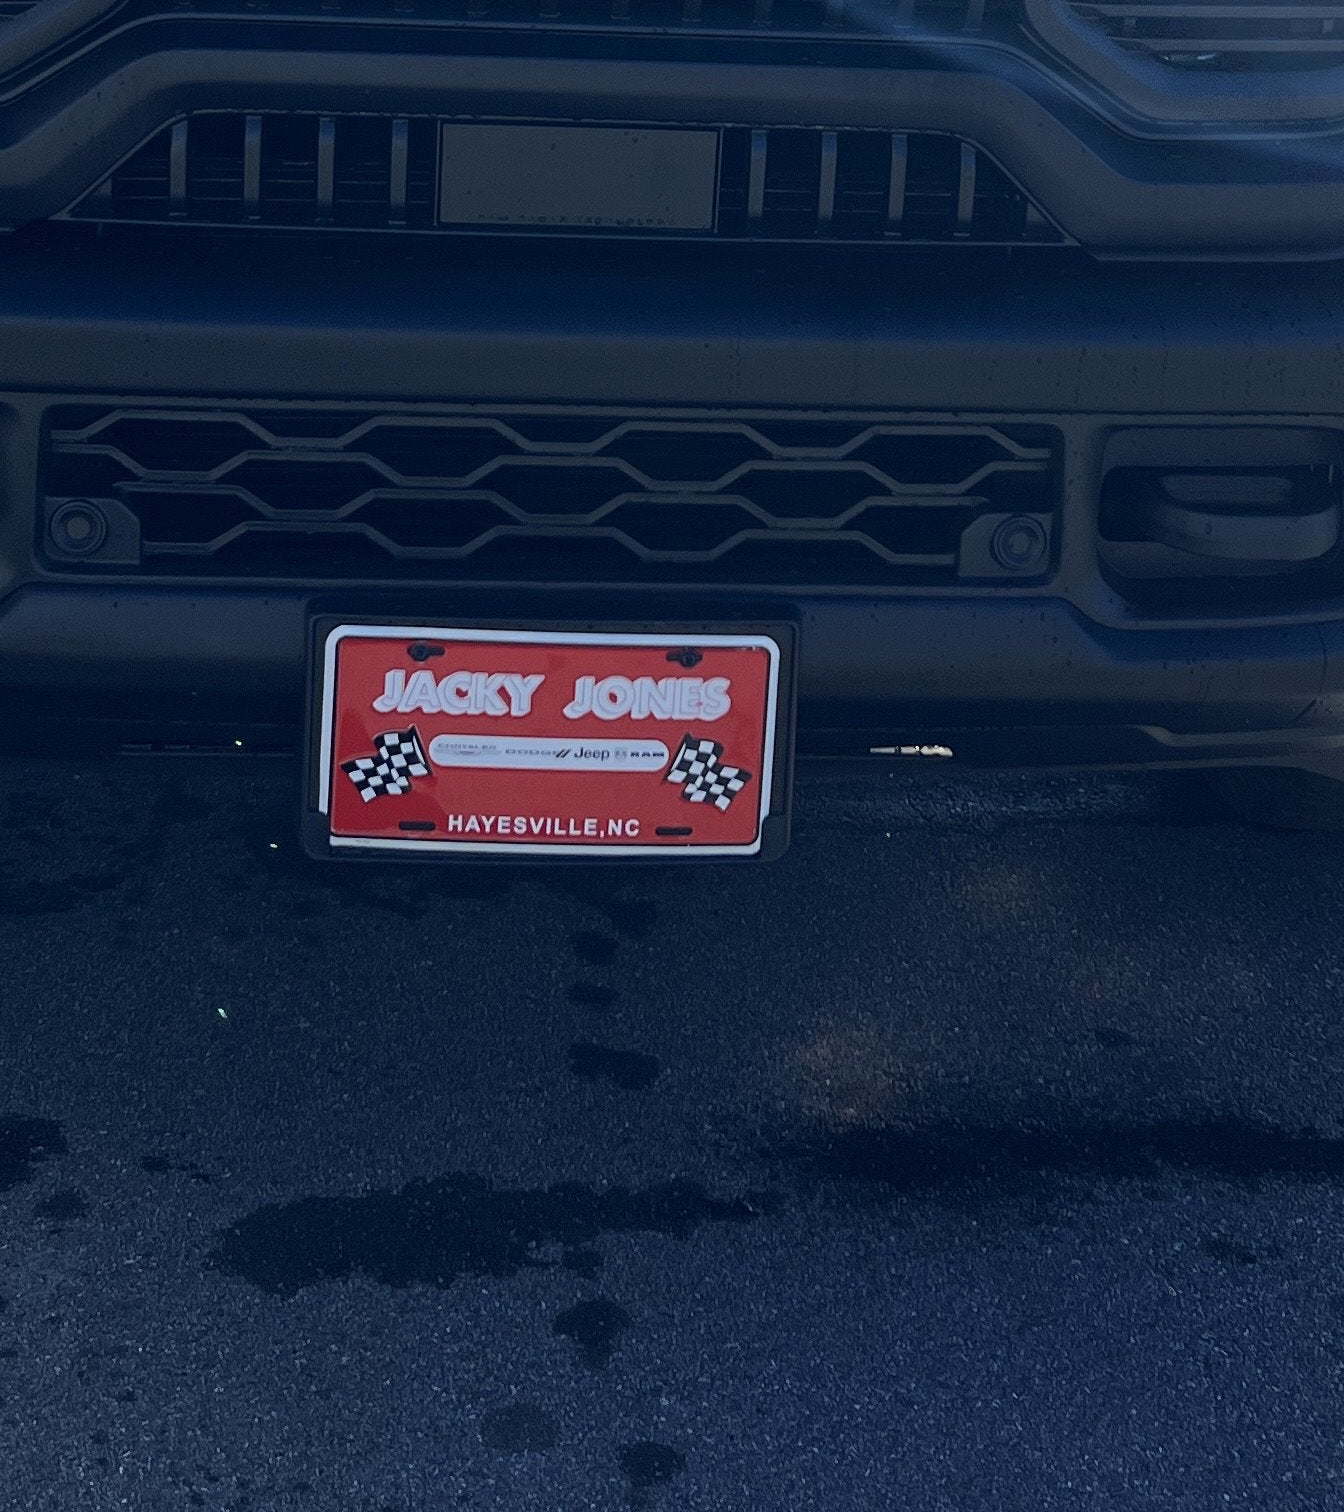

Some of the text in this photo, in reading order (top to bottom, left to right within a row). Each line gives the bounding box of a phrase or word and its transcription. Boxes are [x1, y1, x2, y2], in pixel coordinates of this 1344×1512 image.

[372, 669, 731, 721] JACKY JONES
[573, 746, 610, 762] Jeep
[448, 813, 640, 838] HAYESVILLE,NC
